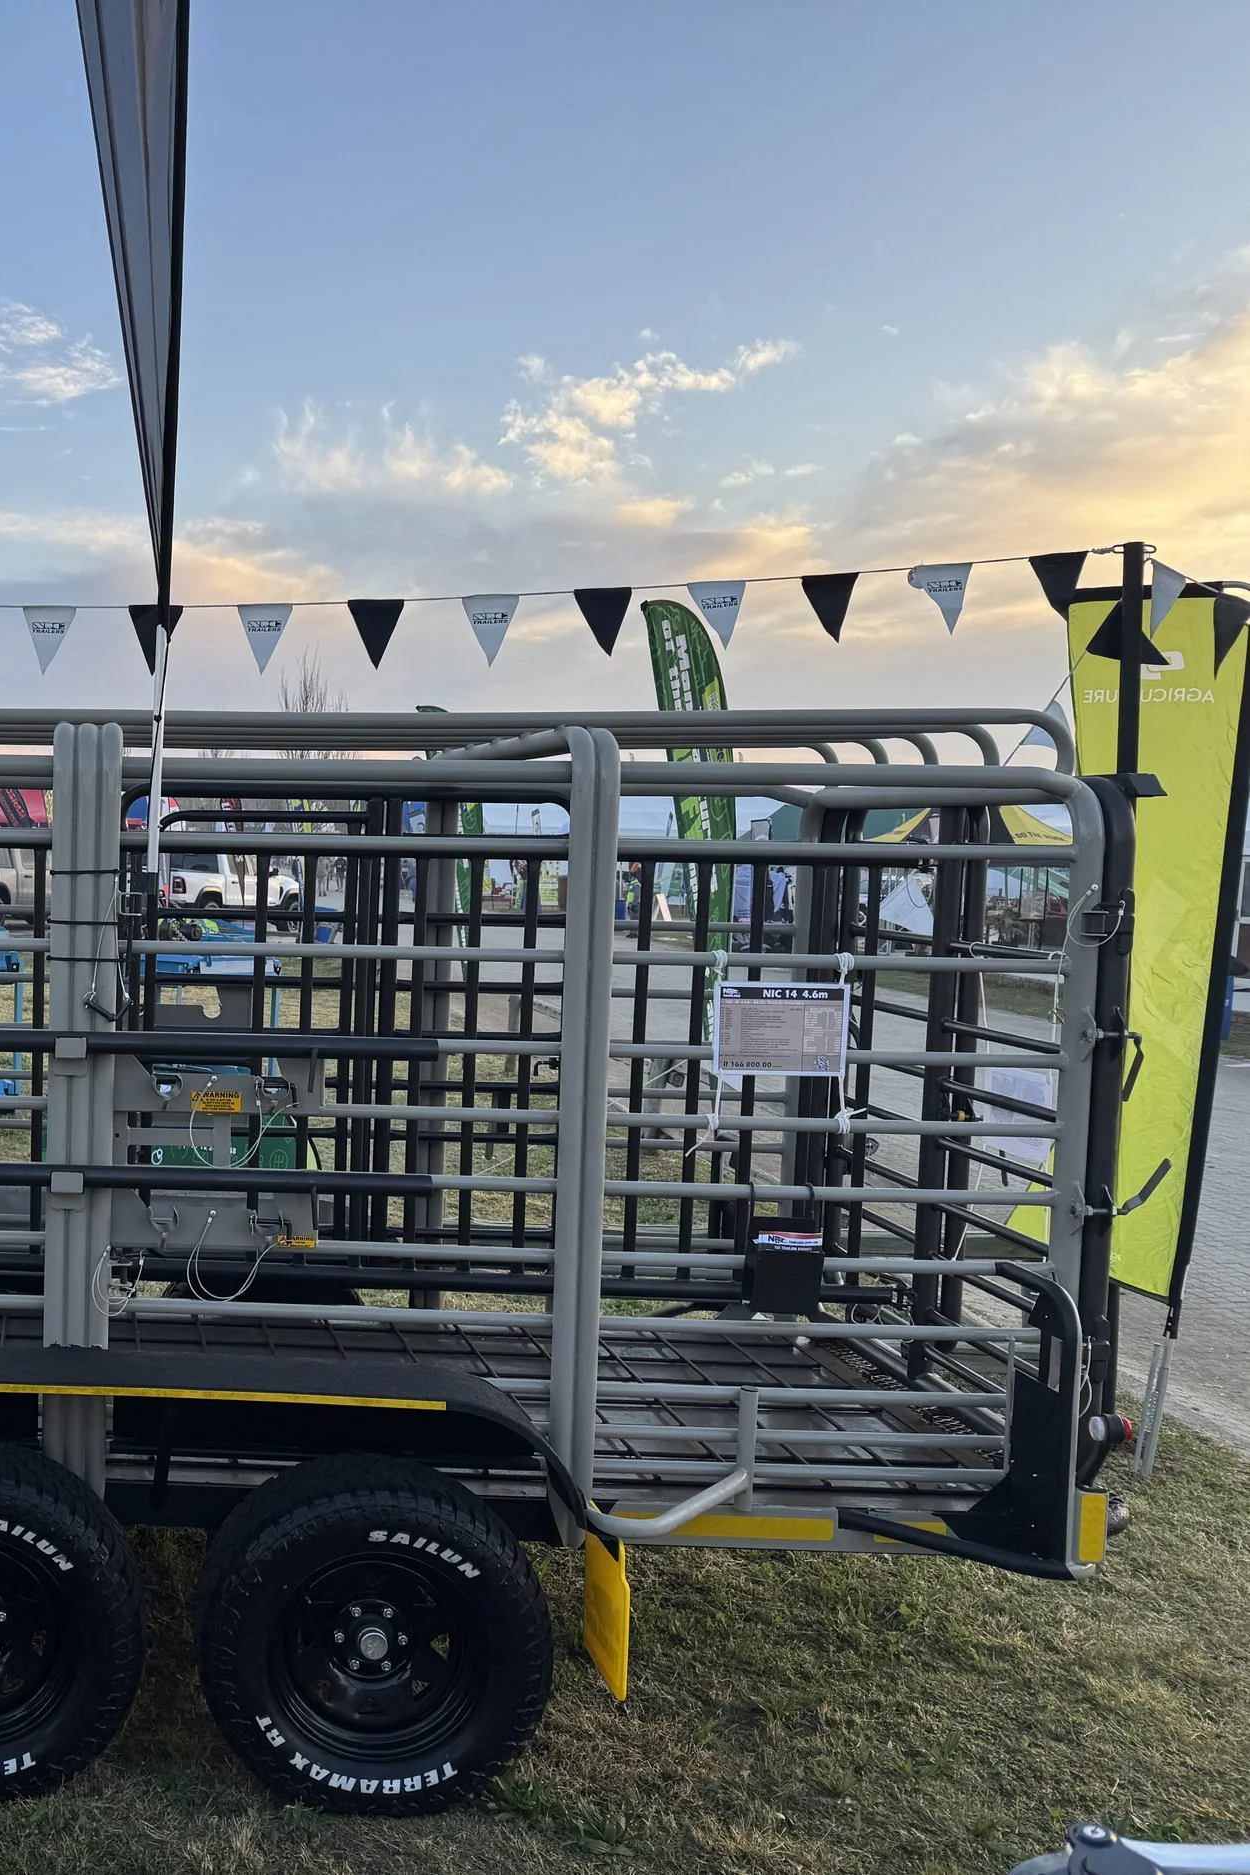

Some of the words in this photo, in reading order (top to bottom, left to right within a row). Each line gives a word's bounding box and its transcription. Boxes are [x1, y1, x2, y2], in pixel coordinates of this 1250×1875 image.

[762, 989, 782, 998] NIC
[785, 989, 798, 998] 14
[802, 990, 828, 998] 4.6m
[367, 1530, 481, 1579] SAILUN
[255, 1715, 286, 1748] RT
[288, 1752, 458, 1795] TERRAMAX
